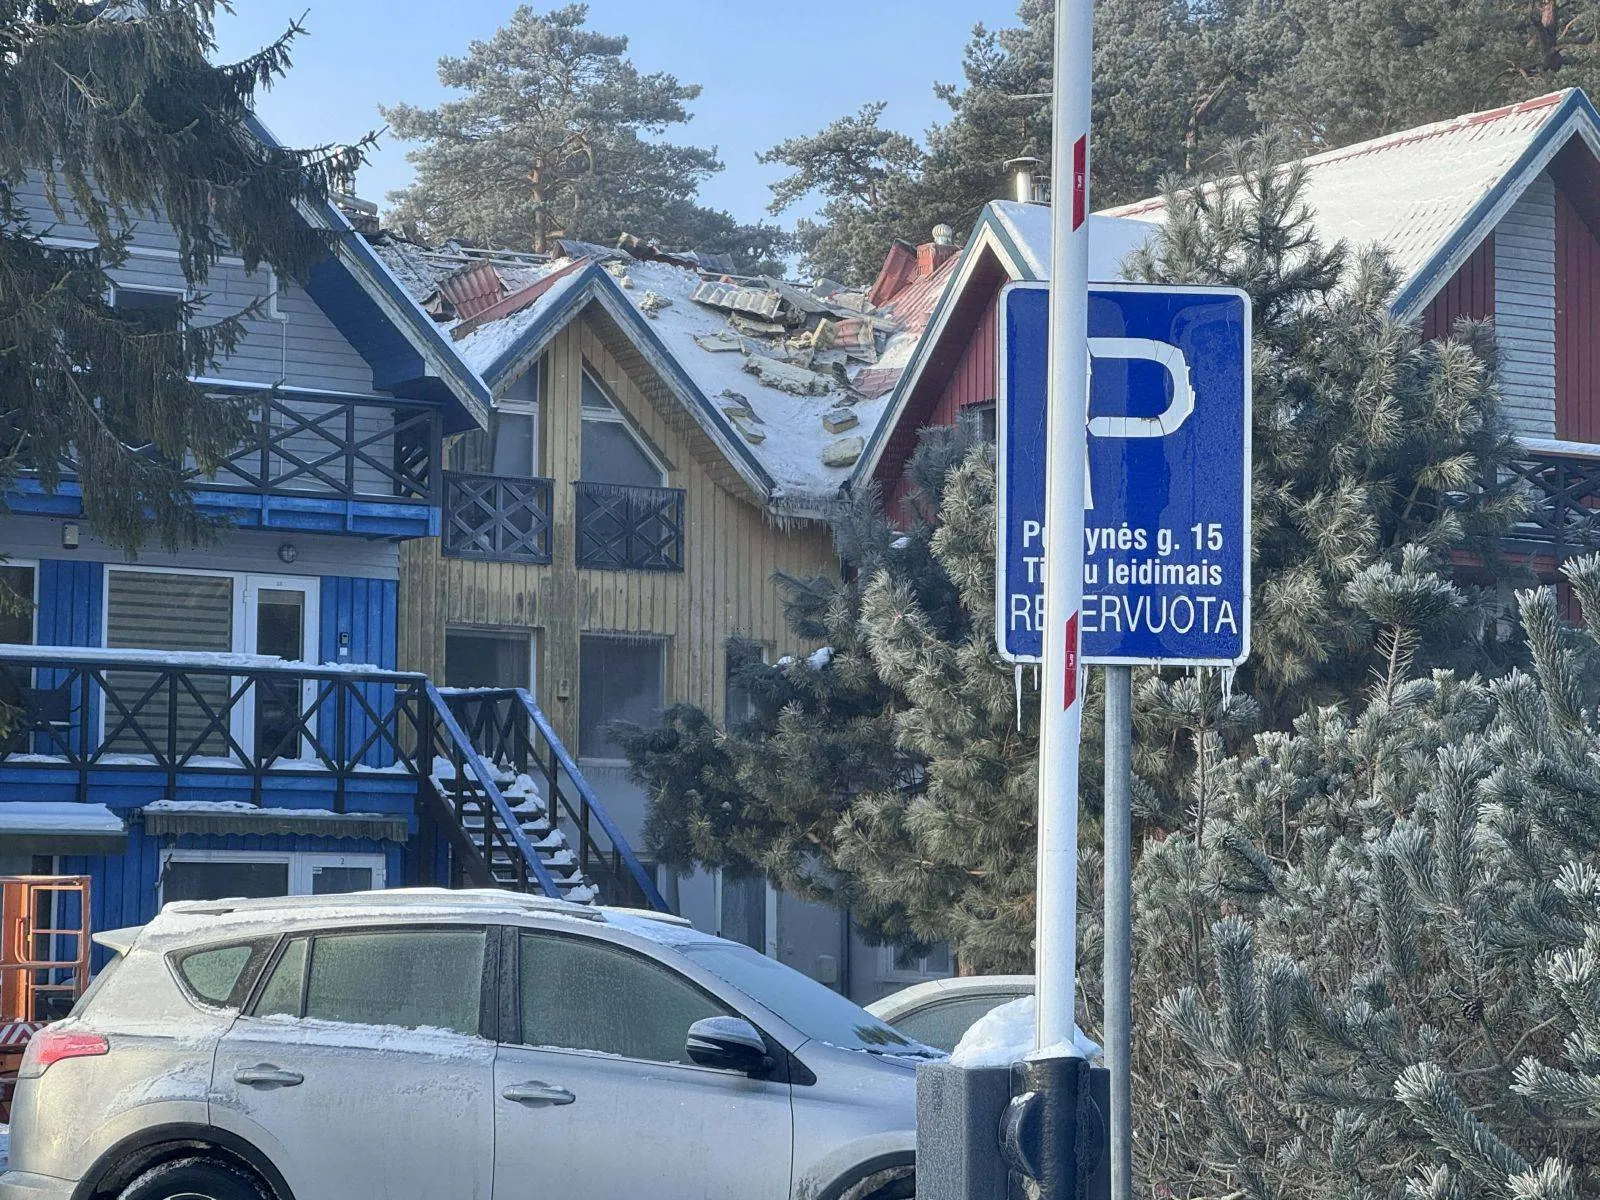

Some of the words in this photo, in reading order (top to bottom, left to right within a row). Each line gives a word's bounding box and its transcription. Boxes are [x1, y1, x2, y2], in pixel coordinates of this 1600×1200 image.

[1083, 337, 1195, 510] P
[1023, 520, 1147, 556] Pynės
[1157, 528, 1180, 556] g.
[1190, 522, 1223, 551] 15
[1108, 558, 1222, 585] leidimais
[1011, 594, 1237, 634] REERVUOTA
